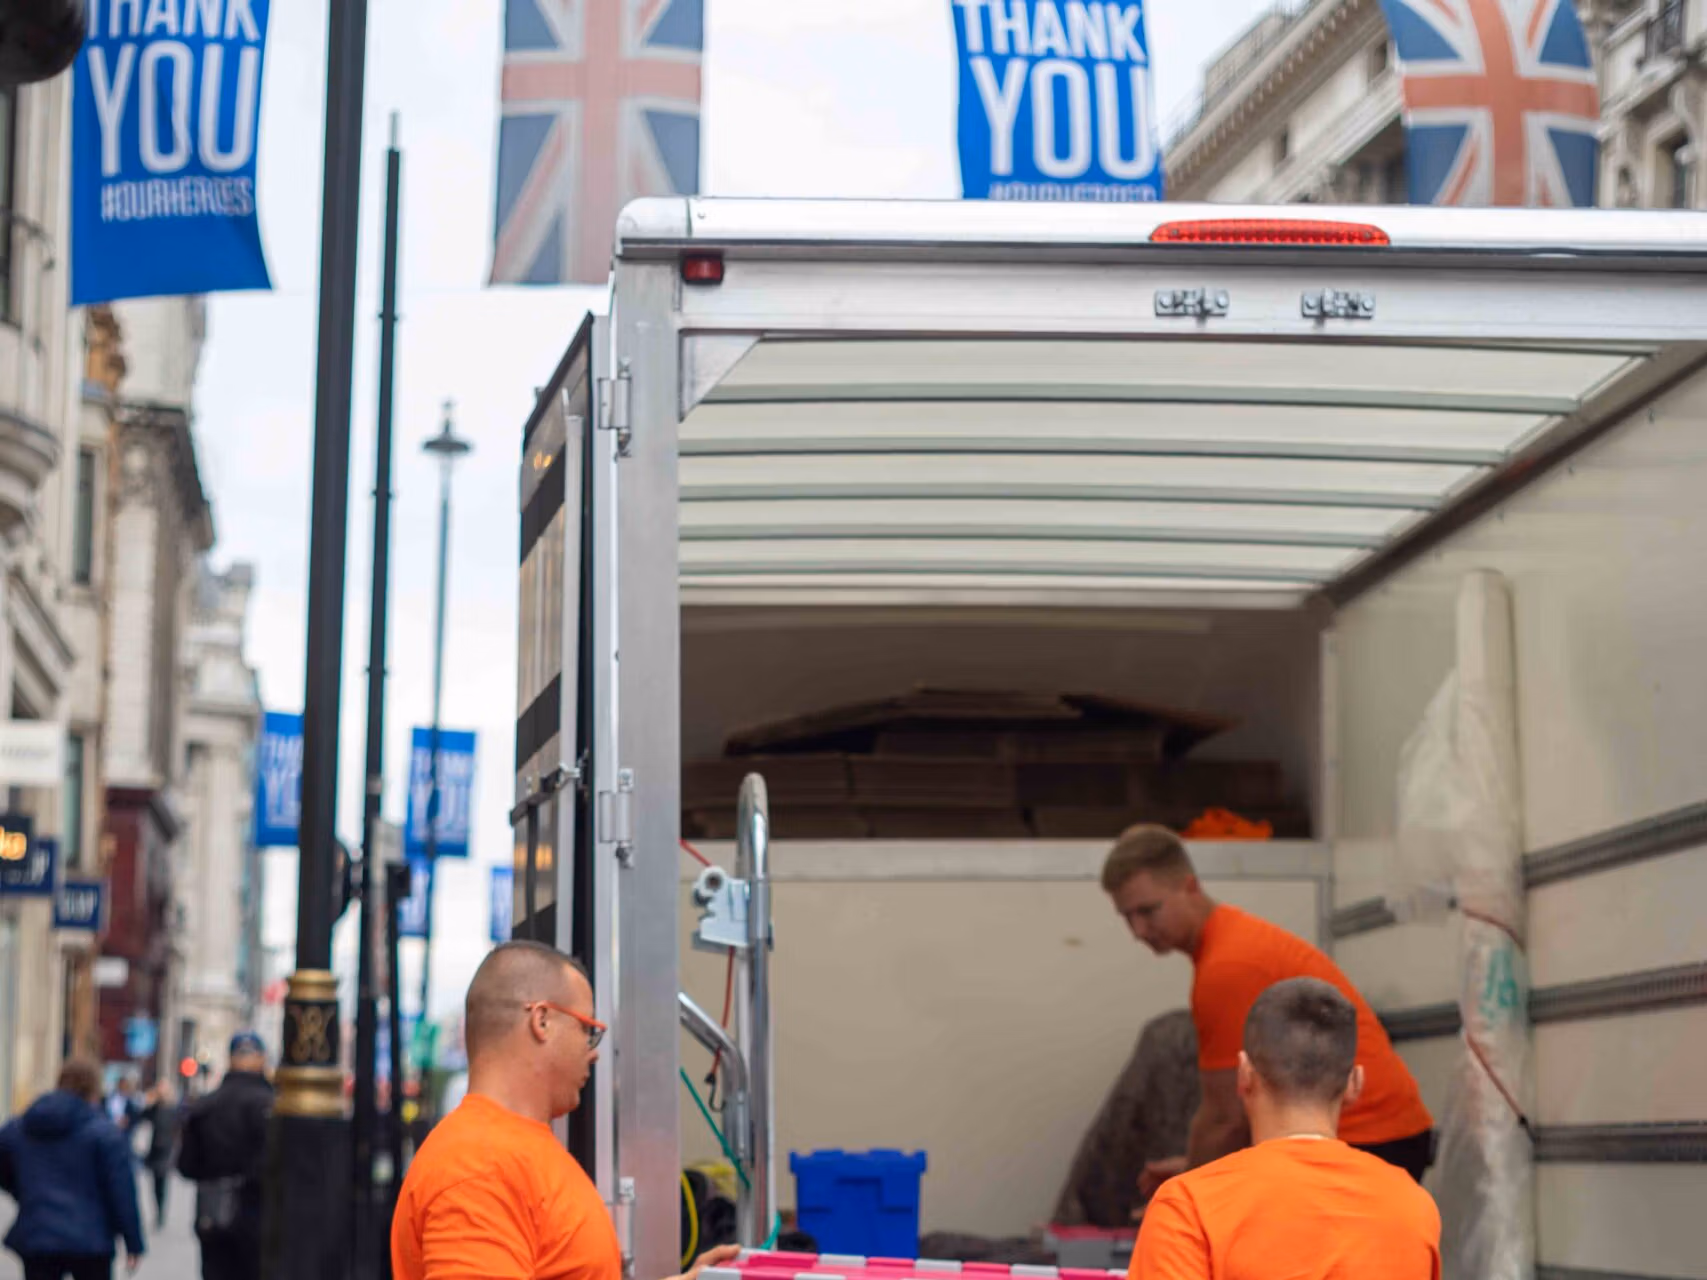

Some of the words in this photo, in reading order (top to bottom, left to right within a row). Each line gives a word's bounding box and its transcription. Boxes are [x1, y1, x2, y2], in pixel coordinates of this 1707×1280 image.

[953, 0, 1149, 63] THANK
[87, 40, 261, 177] YOU
[968, 57, 1157, 180] YOU
